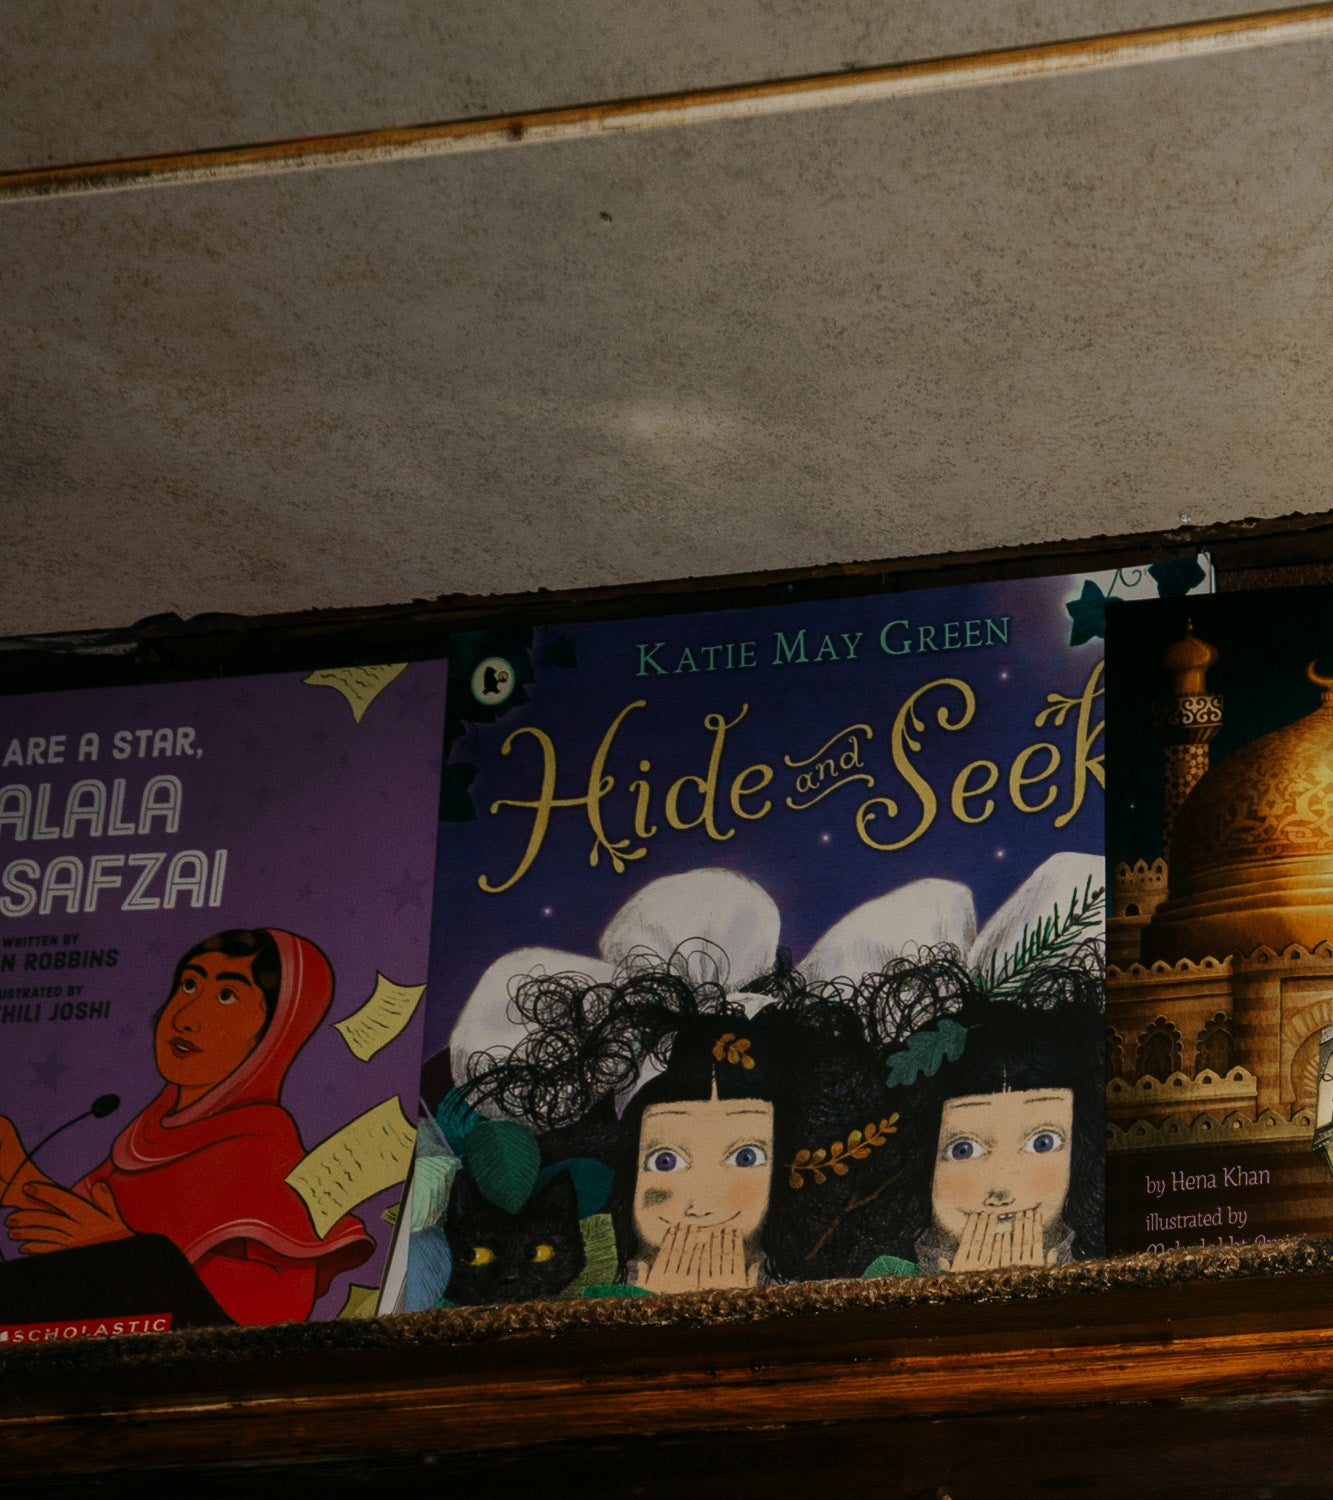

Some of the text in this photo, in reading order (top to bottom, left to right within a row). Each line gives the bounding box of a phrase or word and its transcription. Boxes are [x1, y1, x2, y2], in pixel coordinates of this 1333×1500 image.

[635, 616, 1011, 678] KATIE MAY GREEN
[3, 726, 204, 767] ARE A STAR,
[477, 661, 1106, 893] Hide and Seek
[0, 774, 183, 841] ALALA
[0, 848, 228, 918] SAFZAI
[2, 933, 80, 949] WRITTEN BY
[24, 949, 119, 971] ROBBINS
[48, 1000, 111, 1021] JOSHI
[1145, 1165, 1270, 1198] by Hena Khan
[1145, 1206, 1248, 1232] illustrated by
[12, 1318, 167, 1343] SCHOLASTIC
